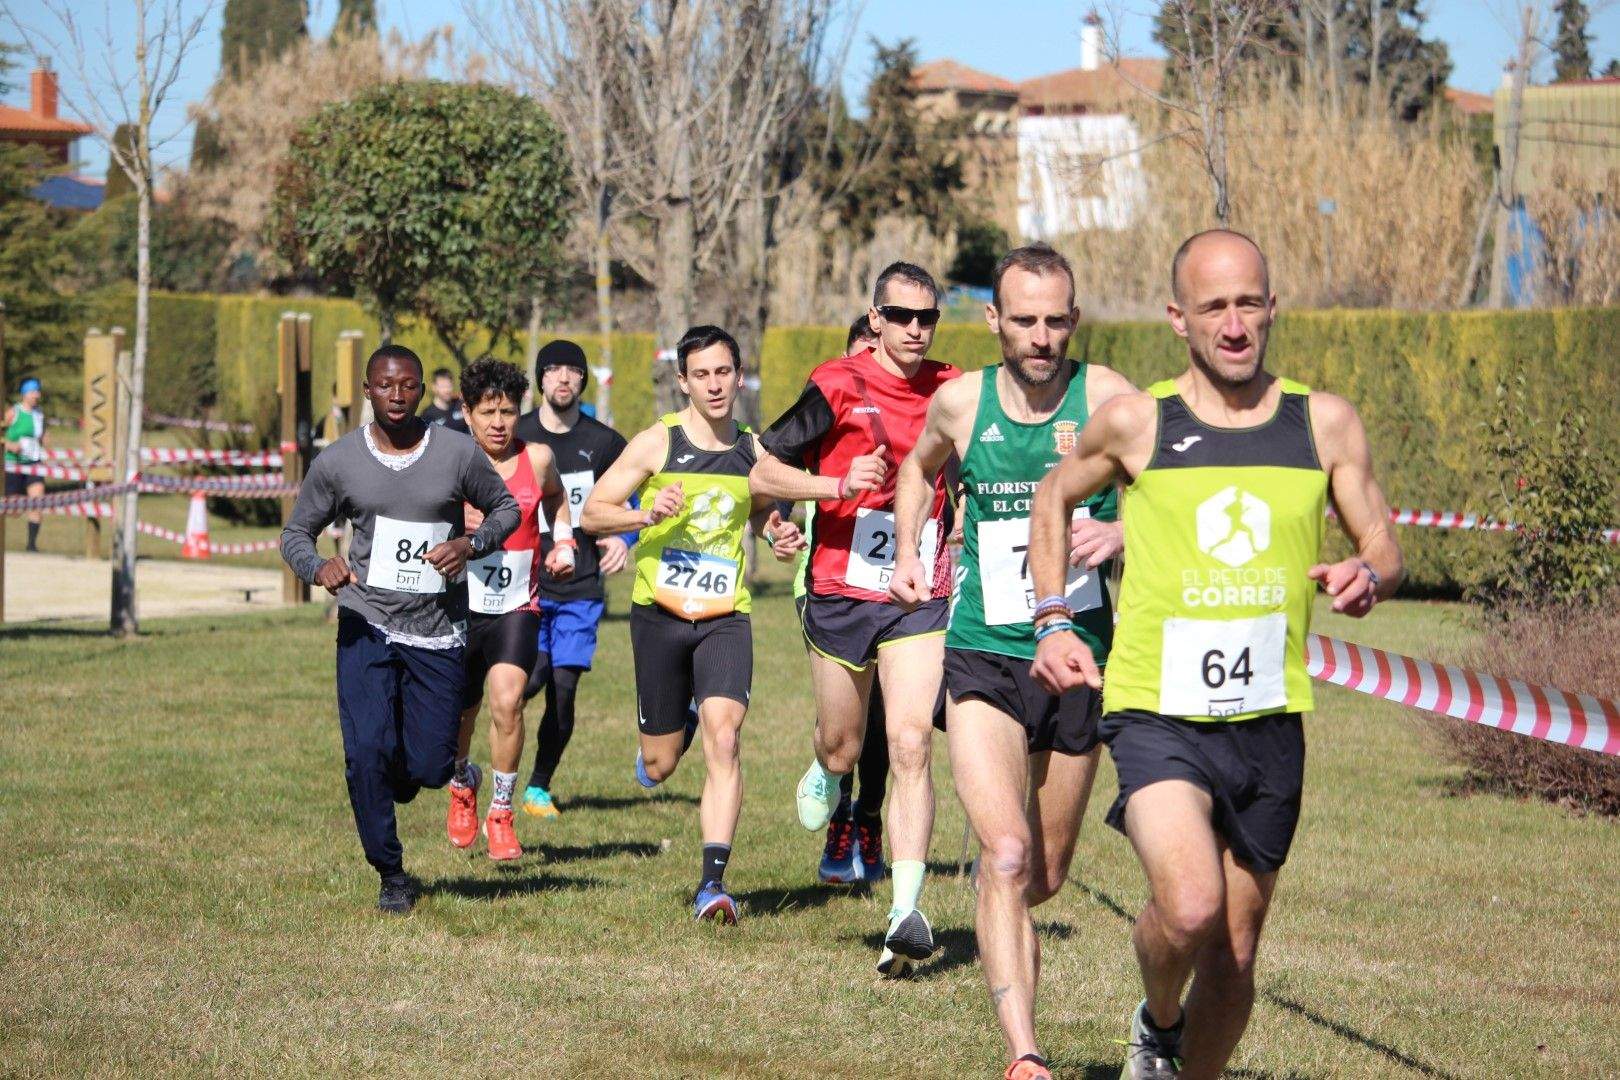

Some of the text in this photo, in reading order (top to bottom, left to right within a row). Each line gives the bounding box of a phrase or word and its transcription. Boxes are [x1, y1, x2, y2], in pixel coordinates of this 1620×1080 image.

[570, 487, 583, 505] 5
[977, 481, 1040, 495] FLORIST
[993, 498, 1033, 513] EL CI
[395, 538, 430, 565] 84
[1011, 544, 1029, 580] 7
[396, 571, 421, 585] bnf
[482, 565, 513, 589] 79
[664, 563, 728, 595] 2746
[1182, 567, 1287, 586] EL RETO DE
[483, 595, 505, 609] bnf
[1182, 585, 1286, 608] CORRER
[1202, 646, 1254, 689] 64
